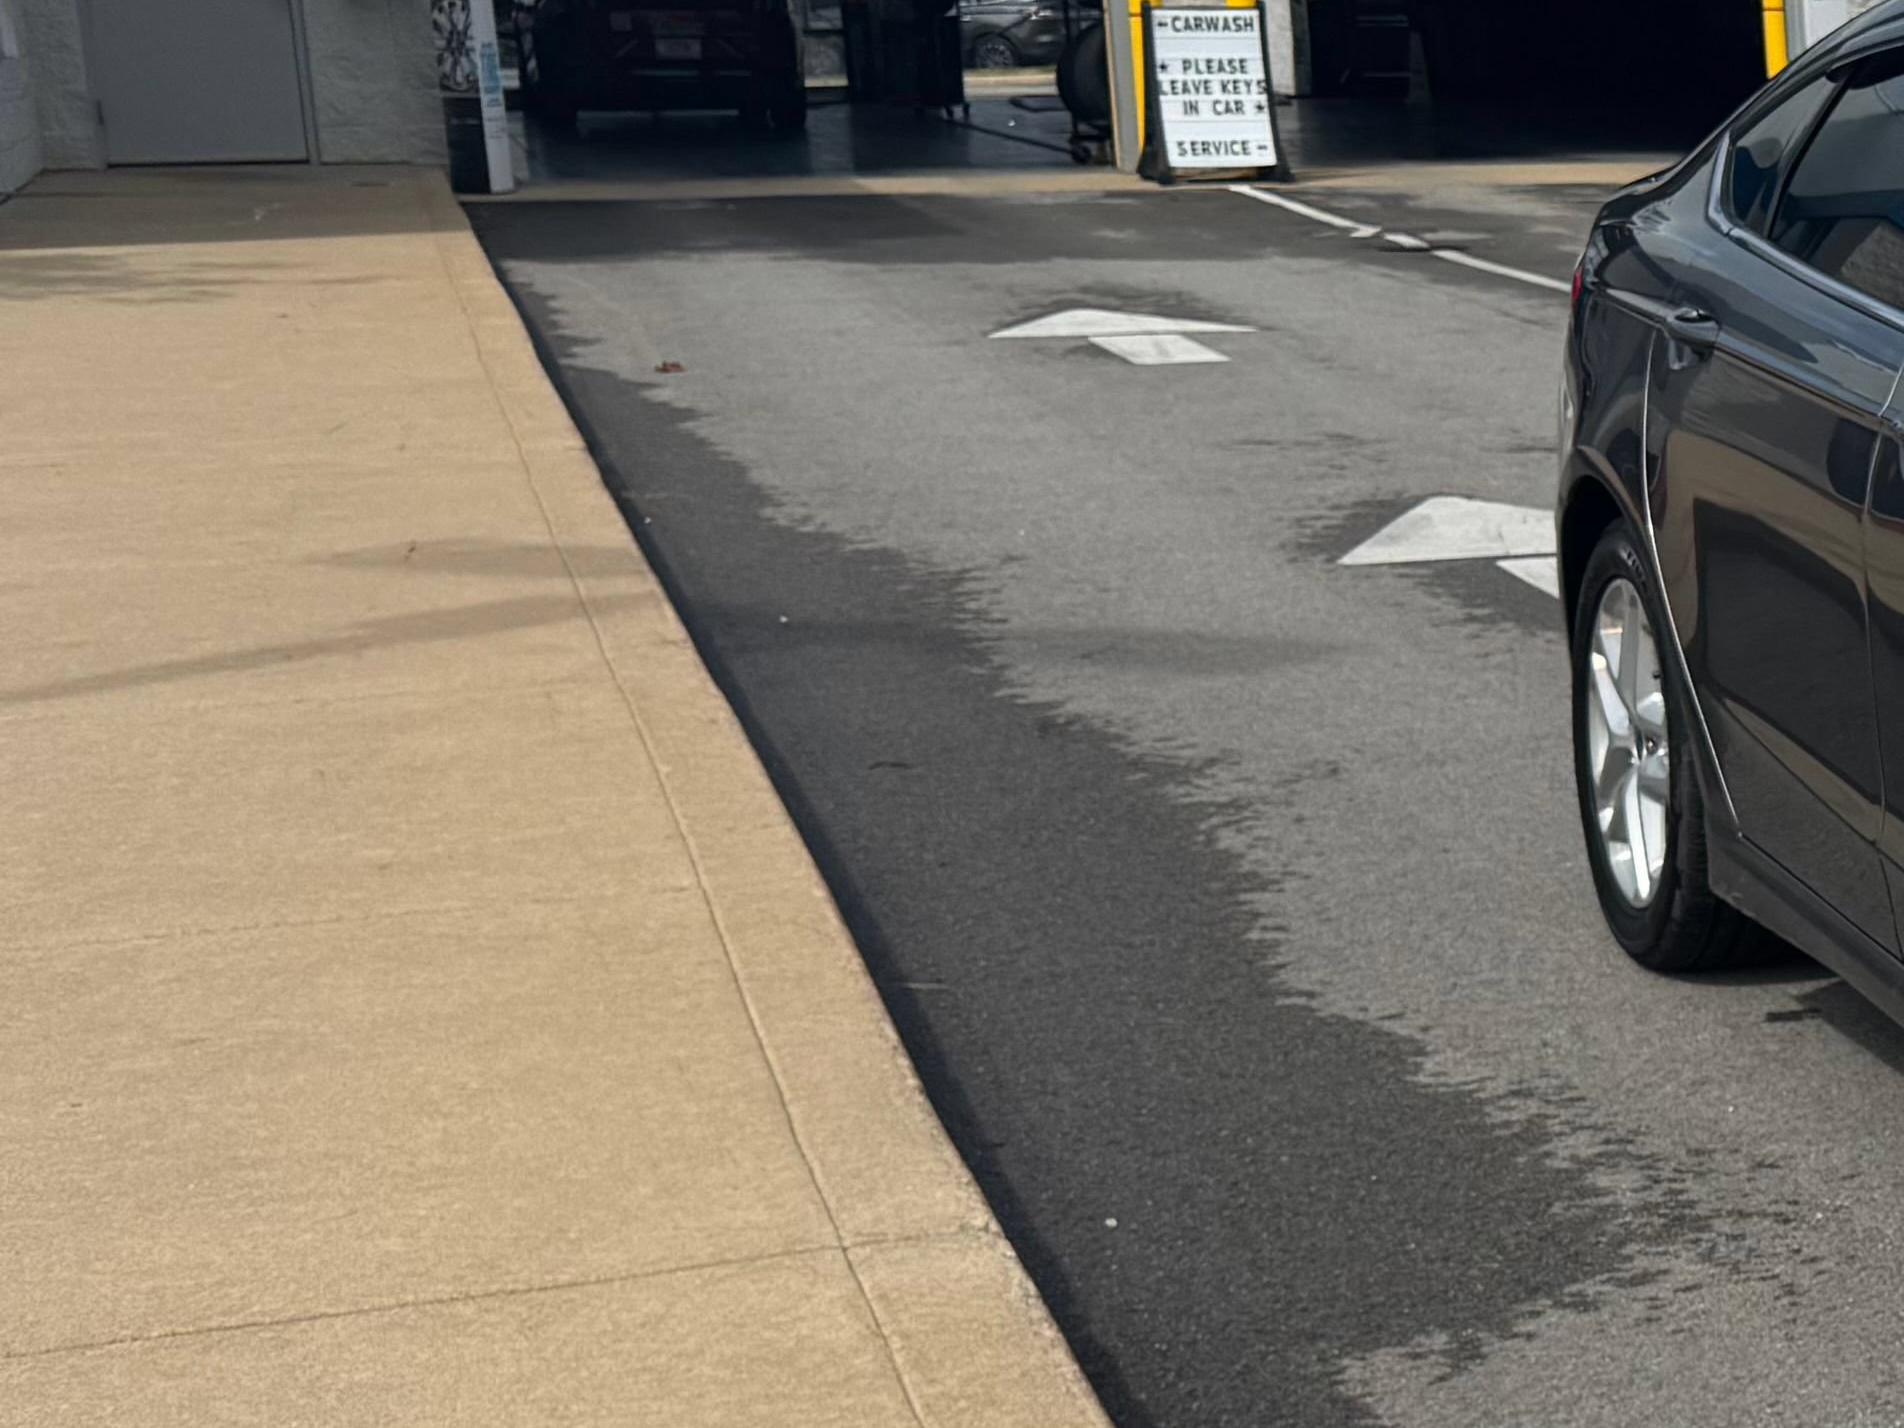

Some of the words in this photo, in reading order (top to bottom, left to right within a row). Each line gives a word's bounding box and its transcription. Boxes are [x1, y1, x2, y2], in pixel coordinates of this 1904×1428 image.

[1172, 17, 1254, 33] CARWASH
[1182, 59, 1248, 74] PLEASE
[1160, 80, 1213, 96] LEAVE
[1221, 79, 1268, 95] KEYS
[1183, 101, 1199, 116] IN
[1213, 100, 1245, 115] CAR
[1177, 141, 1251, 156] SERVICE
